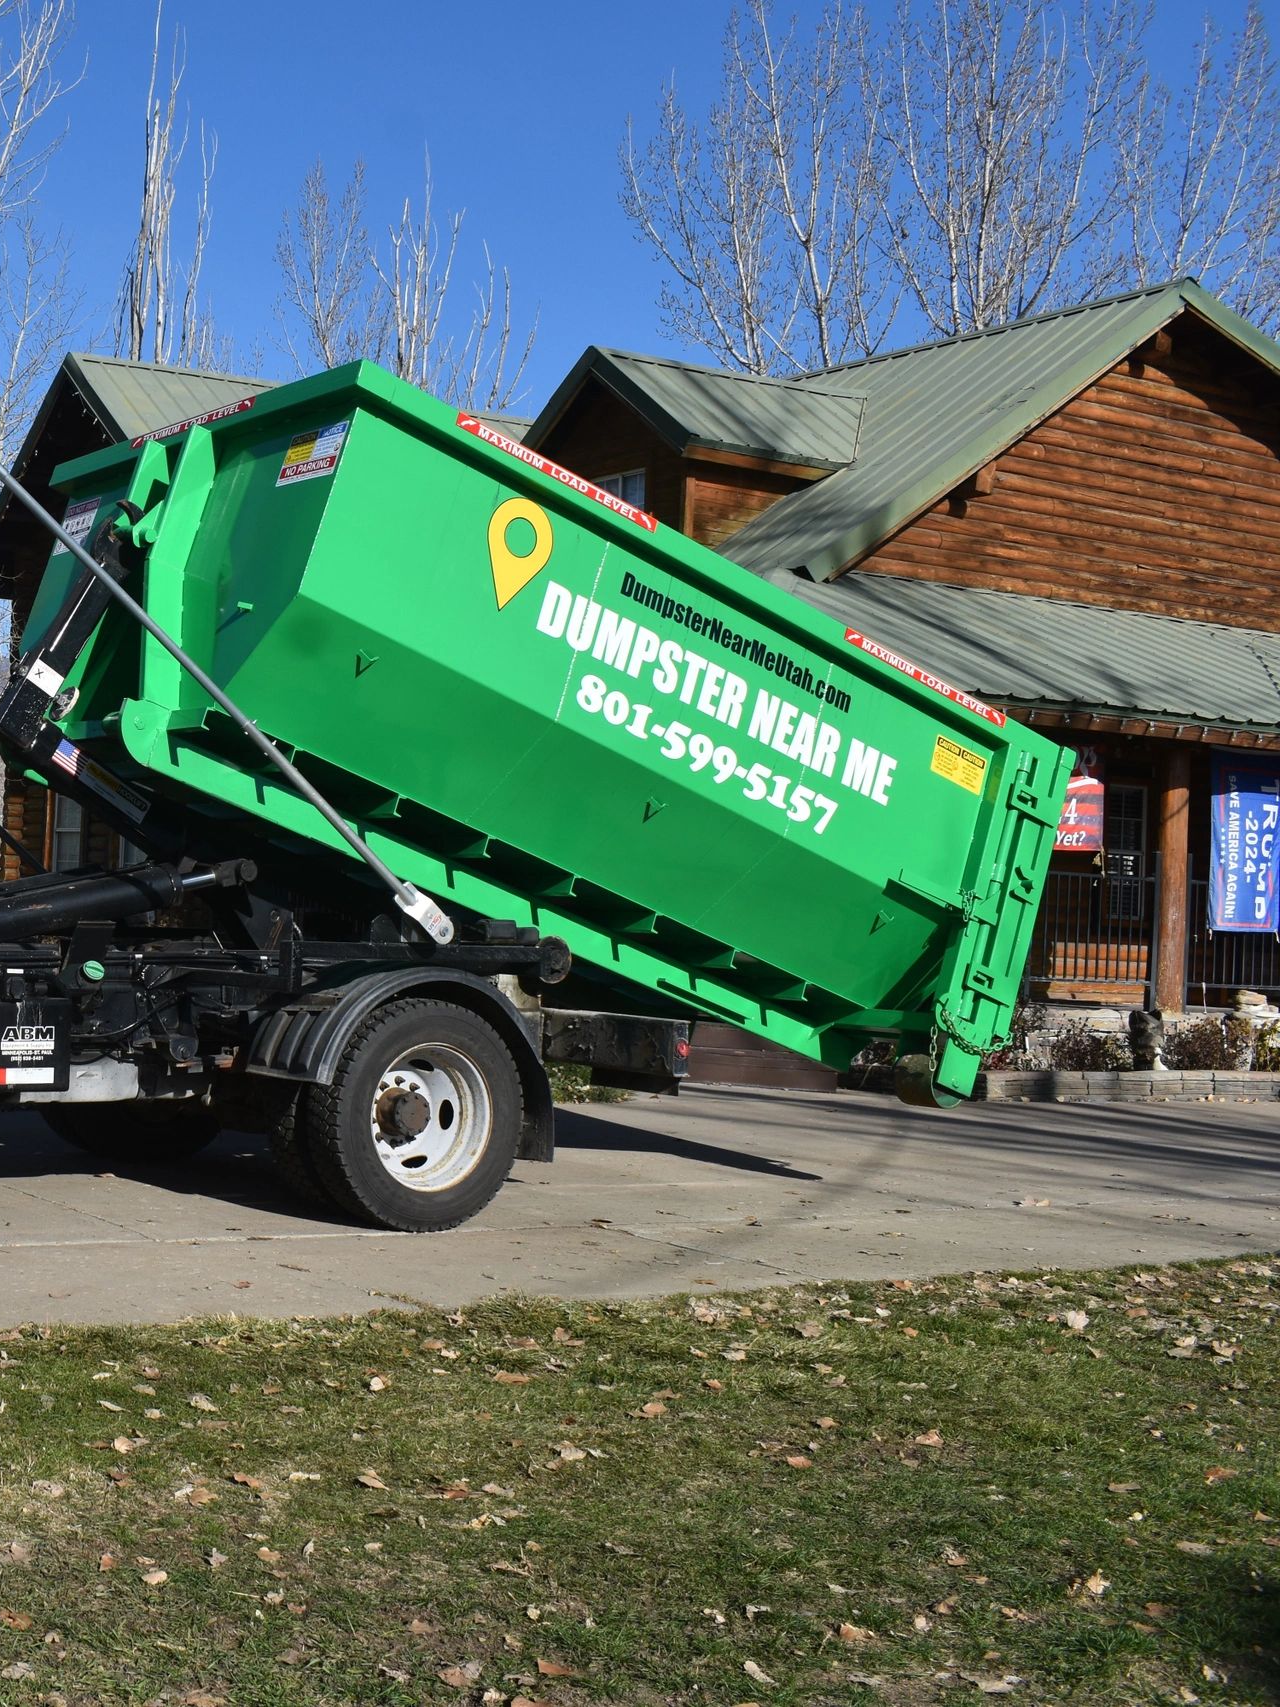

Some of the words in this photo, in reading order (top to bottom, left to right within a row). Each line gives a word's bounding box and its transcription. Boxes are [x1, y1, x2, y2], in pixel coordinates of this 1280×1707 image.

[211, 402, 241, 421] LEVEL
[284, 465, 297, 477] NO
[297, 457, 331, 475] PARKING
[478, 426, 544, 470] MAXIMUM
[551, 467, 589, 493] LOAD
[595, 491, 636, 521] LEVEL
[620, 571, 852, 713] DumpsterNearMeUtah.com
[536, 580, 748, 729] DUMPSTER
[747, 688, 841, 778] NEAR
[841, 738, 898, 806] ME
[861, 639, 915, 677] MAXIMUM
[920, 673, 951, 696] LOAD
[955, 693, 989, 719] LEVEL
[576, 674, 838, 834] 801-599-5157
[938, 738, 960, 756] CAUTION
[962, 752, 984, 769] CAUTION
[1228, 775, 1240, 808] SAVE
[1056, 830, 1086, 846] Yet?
[1228, 811, 1240, 870] AMERICA
[1224, 873, 1238, 918] AGAIN!
[1, 1026, 55, 1041] ABM
